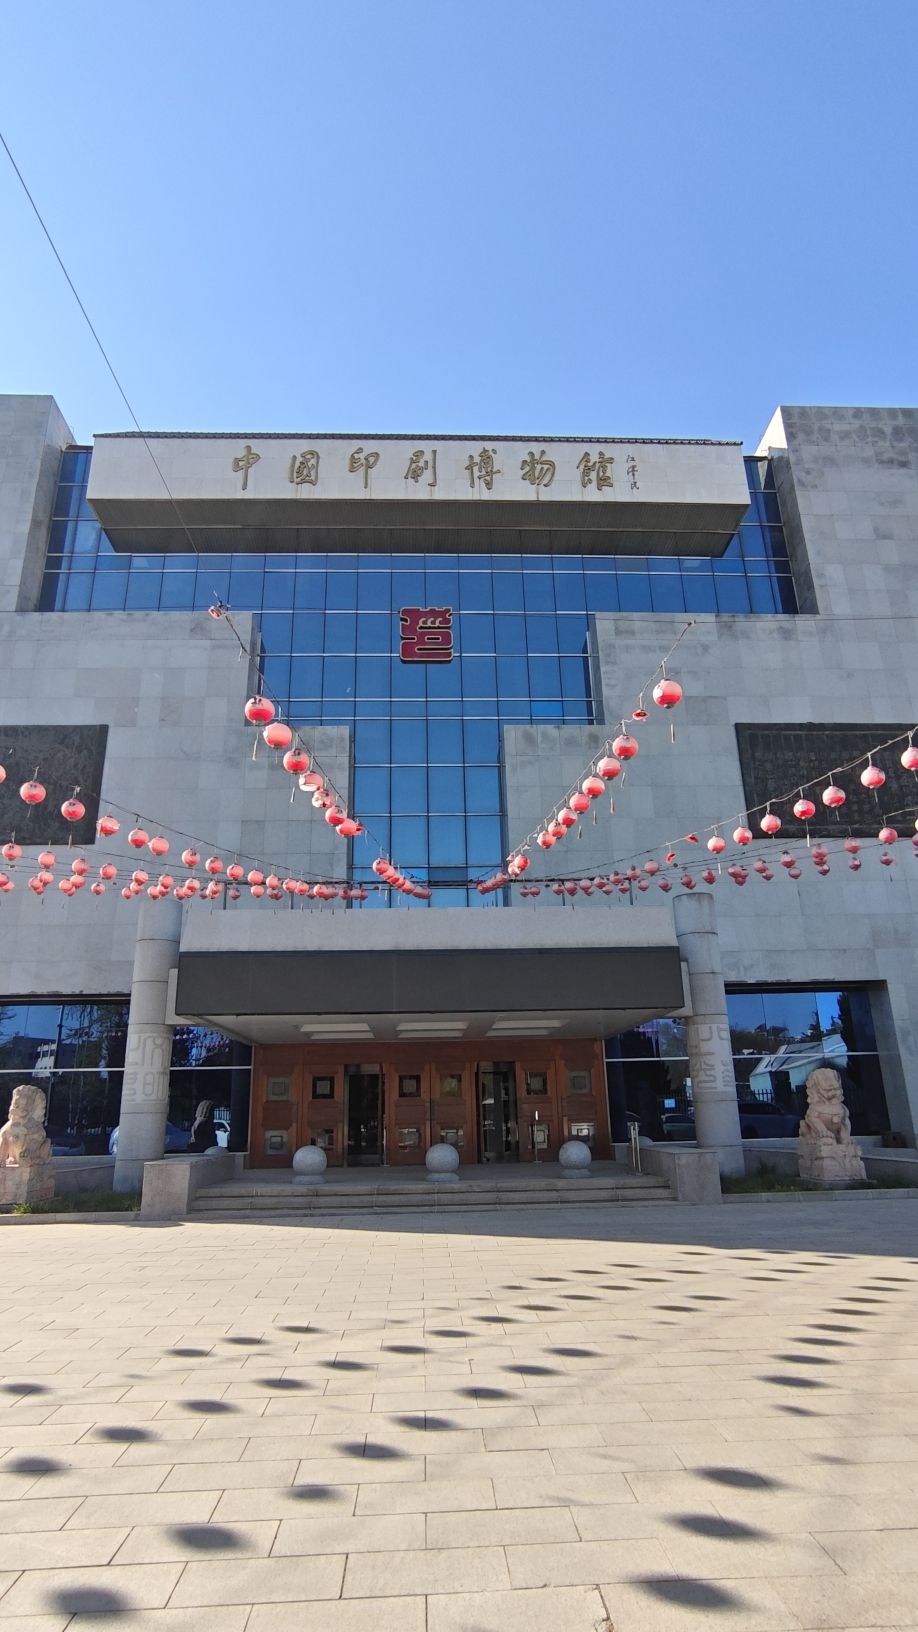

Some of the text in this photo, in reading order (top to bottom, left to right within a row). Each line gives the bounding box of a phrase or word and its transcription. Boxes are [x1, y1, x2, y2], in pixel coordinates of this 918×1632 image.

[231, 444, 615, 491] 中國印刷博物館
